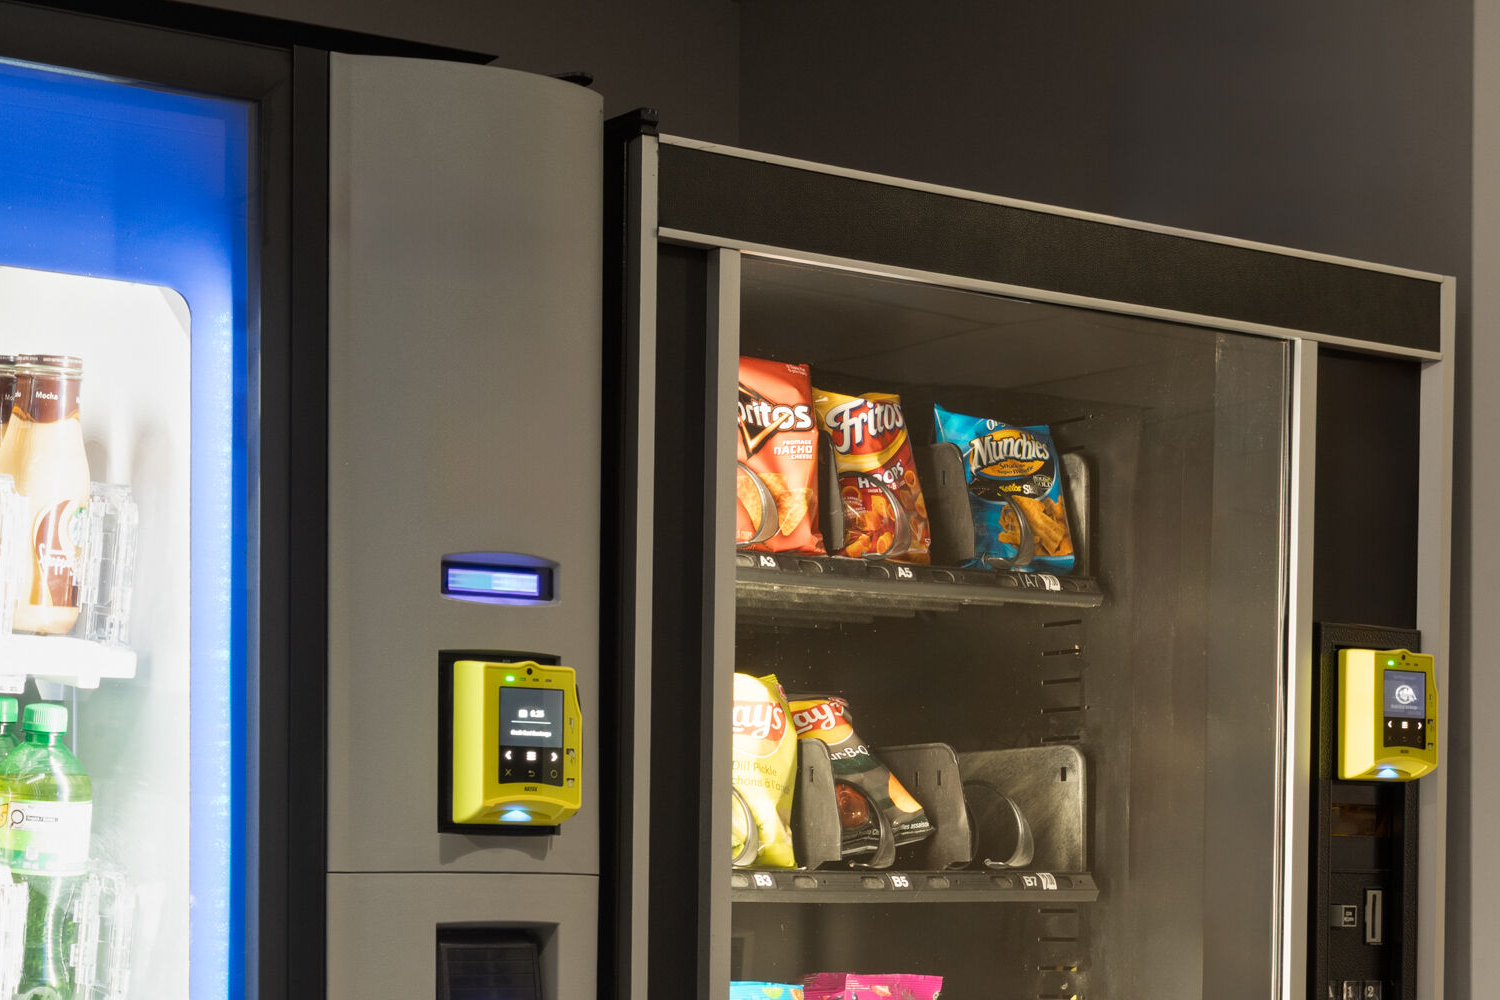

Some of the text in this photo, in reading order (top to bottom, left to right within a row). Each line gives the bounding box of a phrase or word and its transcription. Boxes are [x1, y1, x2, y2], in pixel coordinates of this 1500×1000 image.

[35, 391, 59, 401] Mocha
[737, 401, 813, 431] oritos
[826, 399, 904, 454] Fritos
[971, 434, 1049, 475] Munchies
[760, 555, 776, 568] A3
[898, 566, 913, 578] A5
[1026, 574, 1039, 588] A7
[732, 703, 783, 740] ay's
[754, 874, 772, 886] B3
[892, 875, 909, 888] B5
[1025, 876, 1039, 887] B7
[1367, 985, 1374, 997] 2
